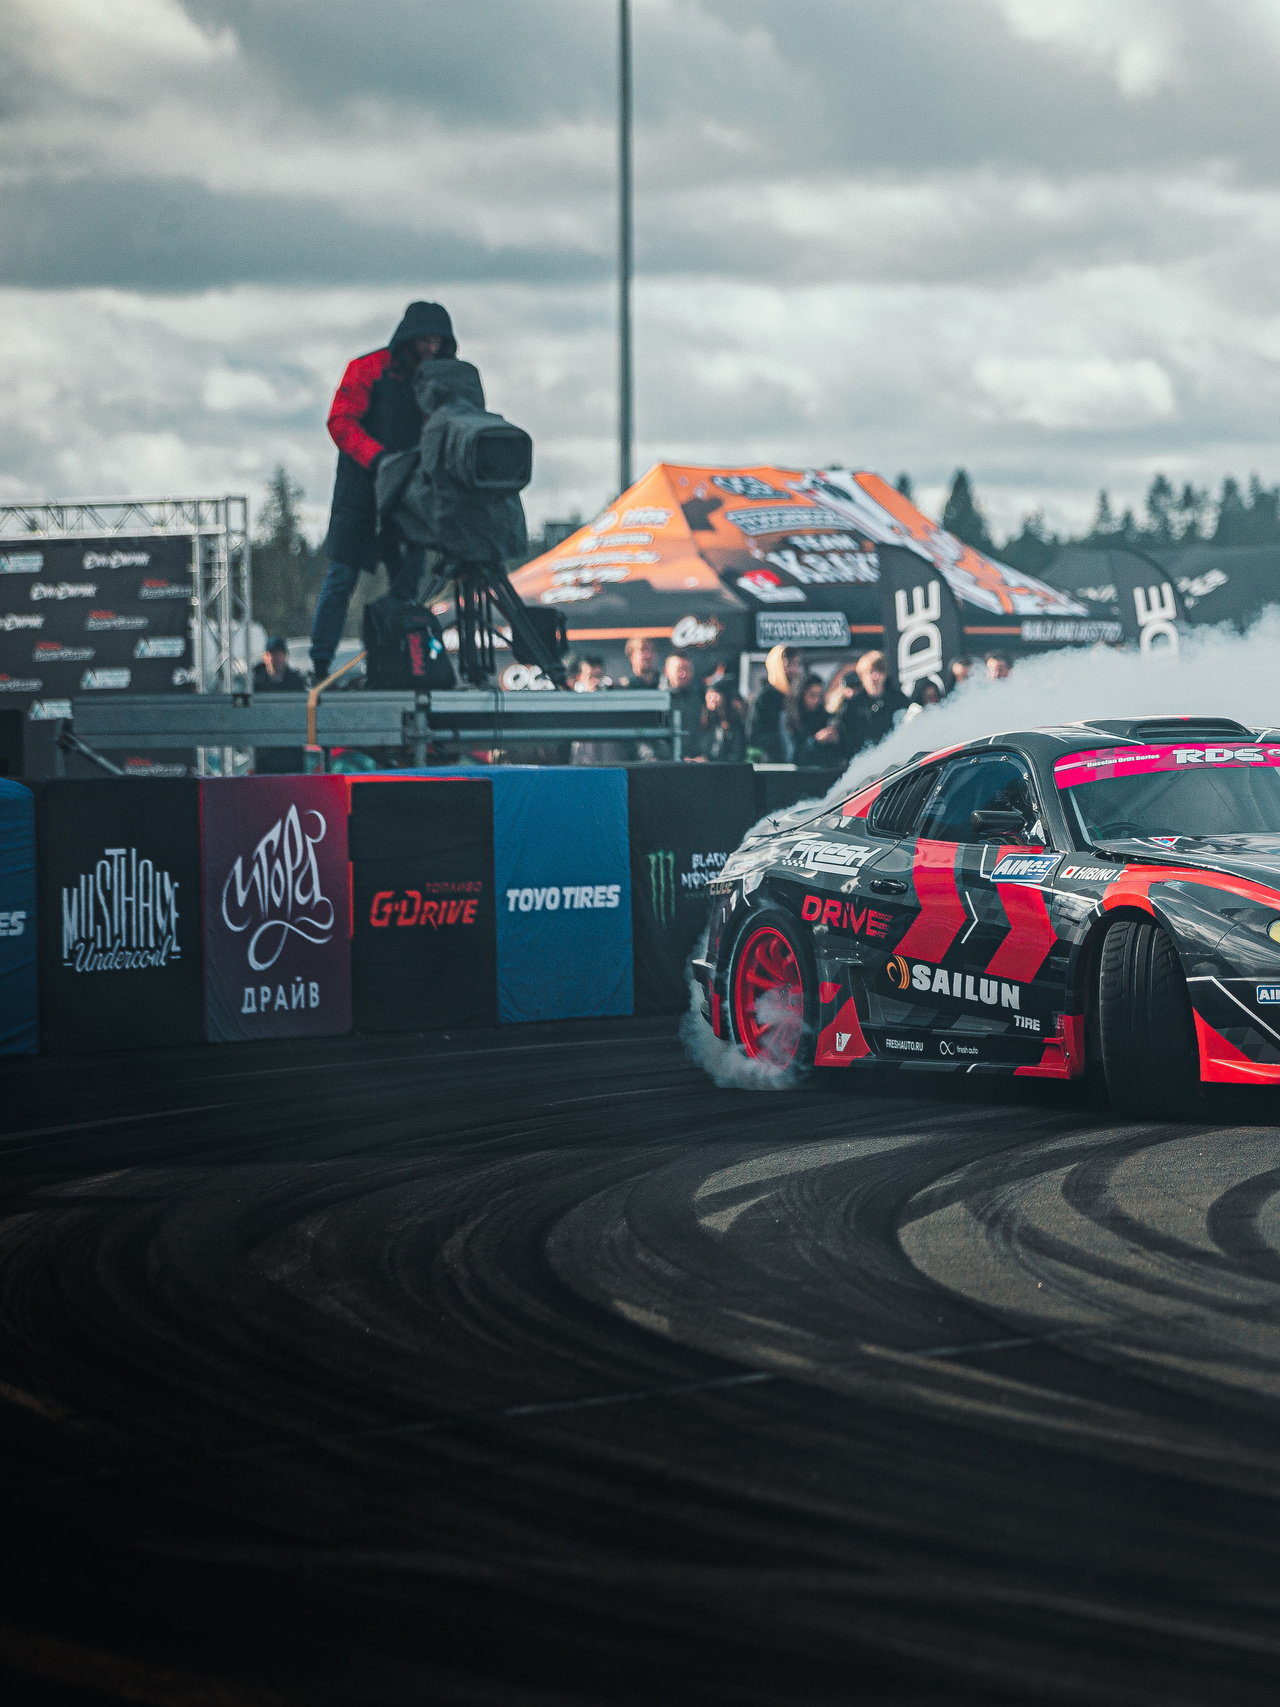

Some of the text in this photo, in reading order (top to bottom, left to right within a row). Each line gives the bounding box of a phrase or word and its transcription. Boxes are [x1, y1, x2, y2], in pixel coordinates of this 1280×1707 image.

[1172, 748, 1265, 764] RDS
[994, 859, 1052, 876] AIMOL
[1073, 866, 1118, 881] HIBINO
[506, 884, 621, 913] TOYO TIRES
[801, 894, 893, 939] DRIVE
[241, 975, 320, 1014] ДРАЙВ
[911, 964, 1021, 1010] SAILUN
[1013, 1014, 1041, 1032] TIRE
[885, 1038, 924, 1052] FRESHAUTO.RU
